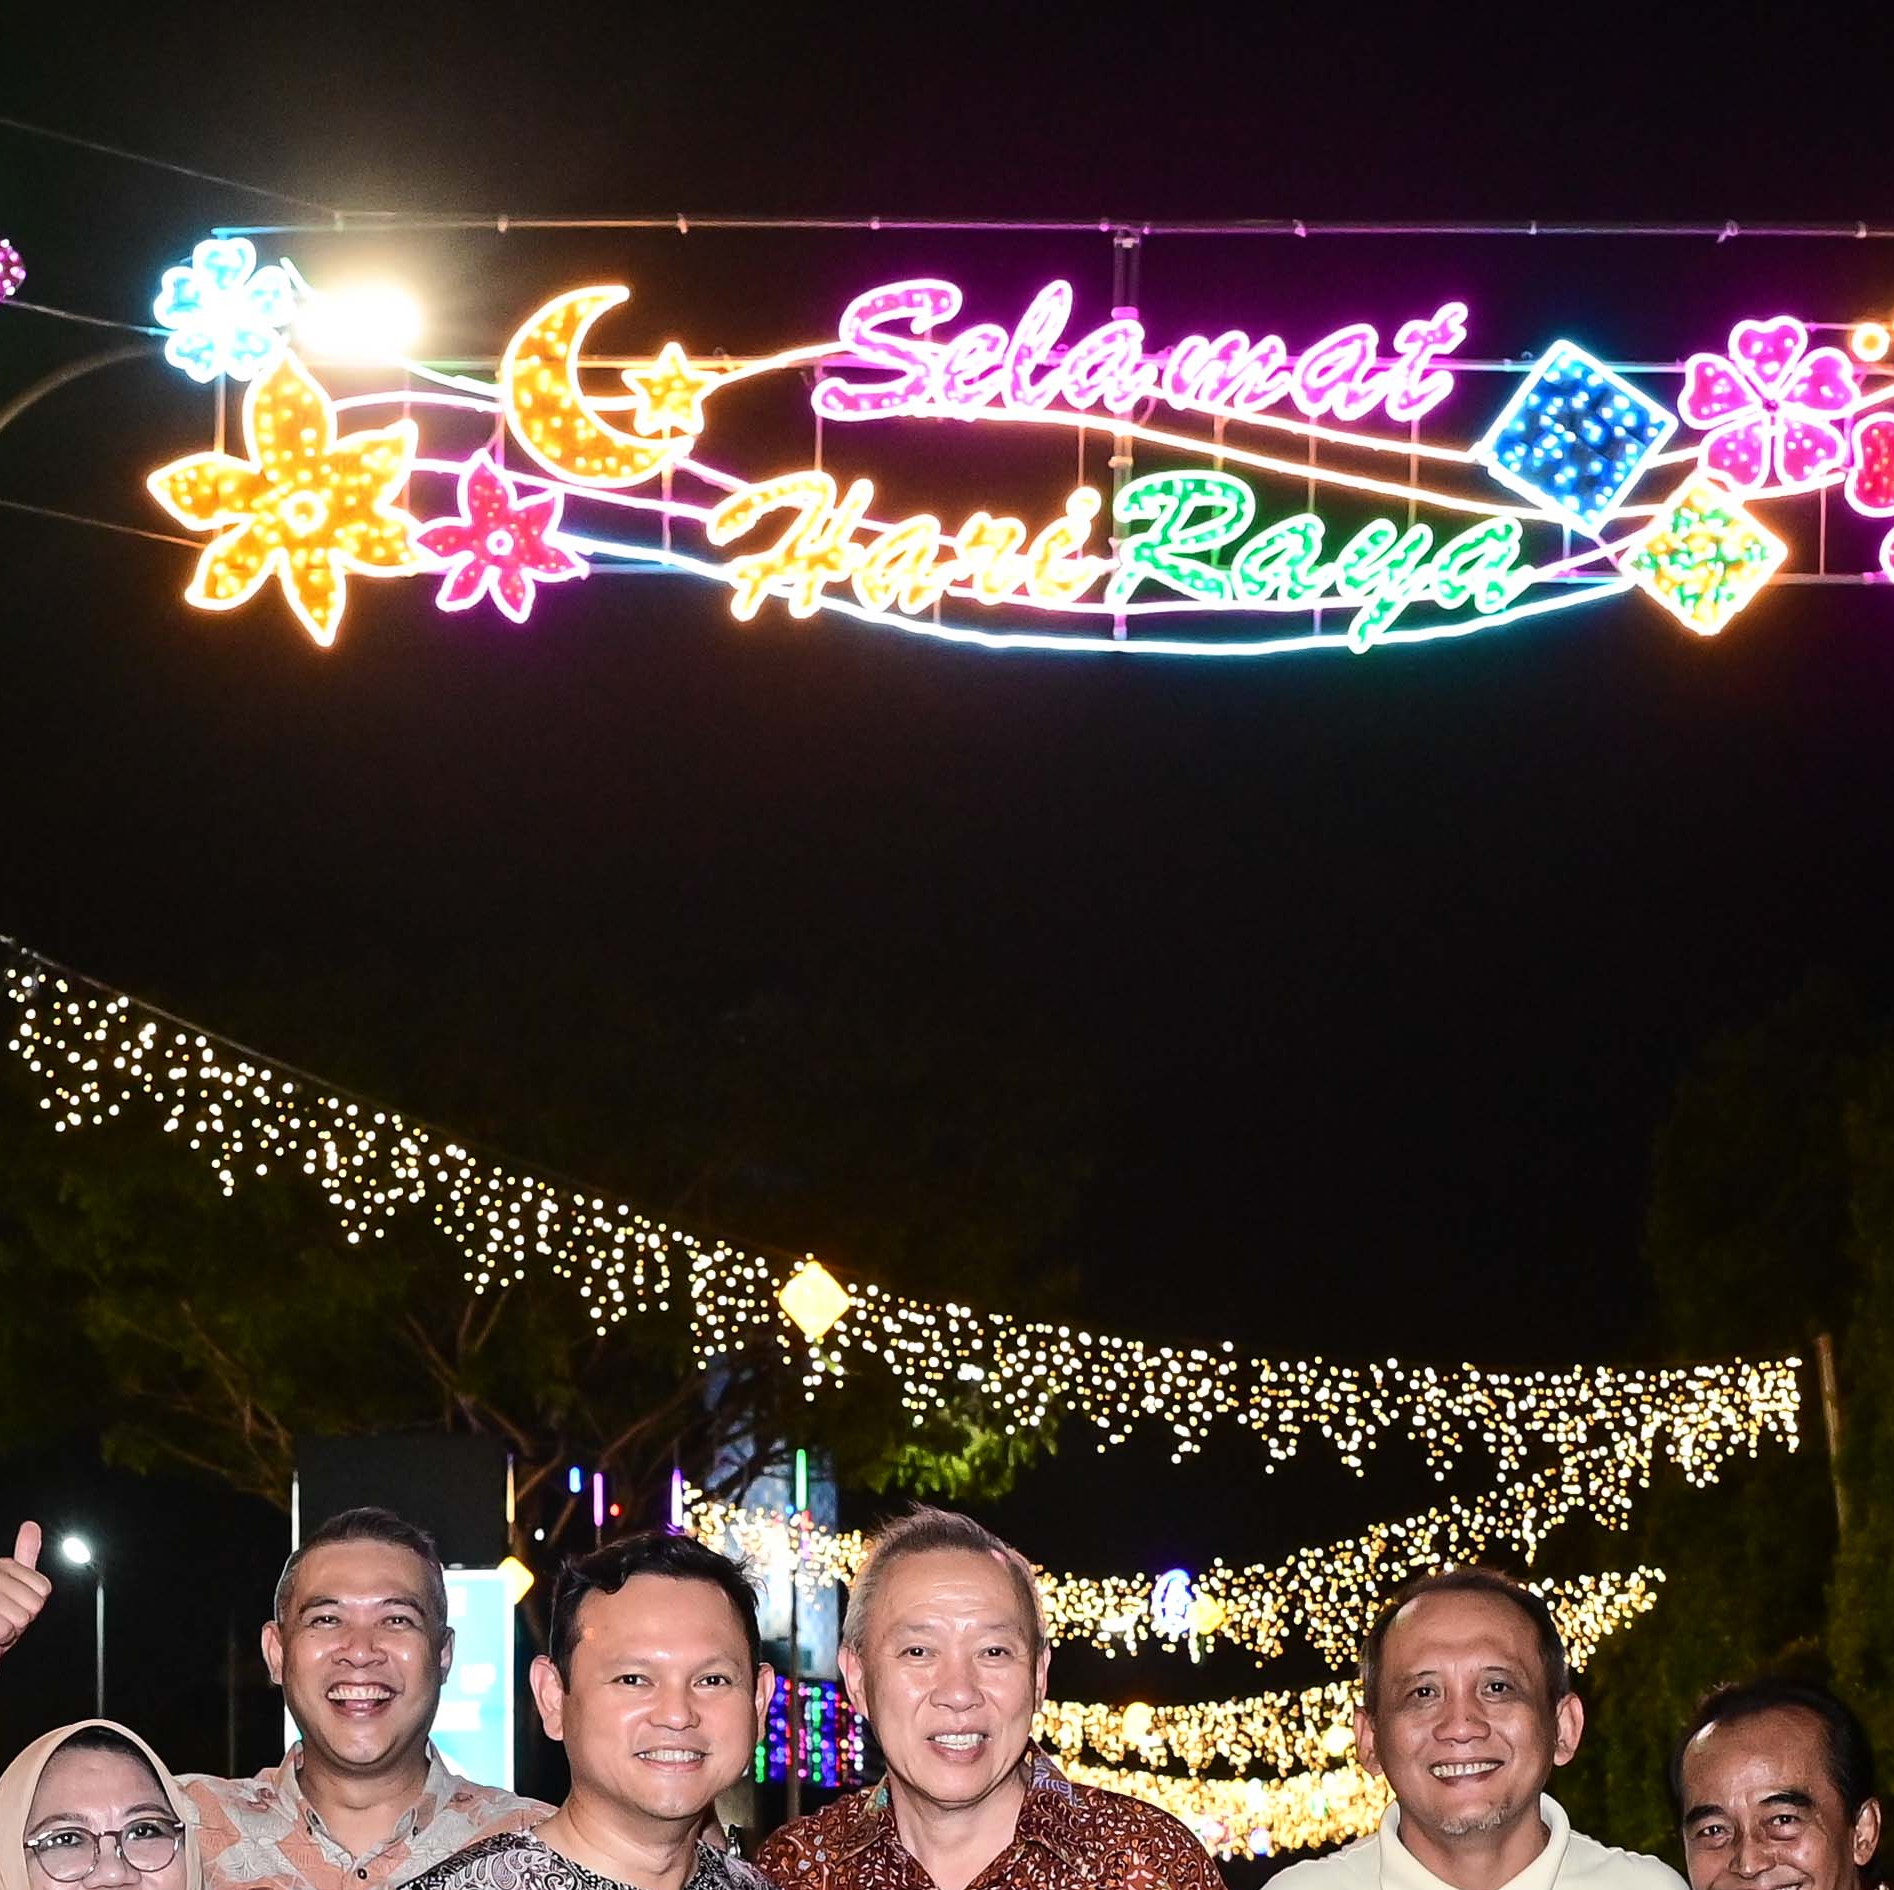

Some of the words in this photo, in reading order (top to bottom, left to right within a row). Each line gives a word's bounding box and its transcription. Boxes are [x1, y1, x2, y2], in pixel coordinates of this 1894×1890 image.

[811, 278, 1470, 421] Selamat
[705, 470, 1102, 621] Hari
[1104, 469, 1536, 655] Raya
